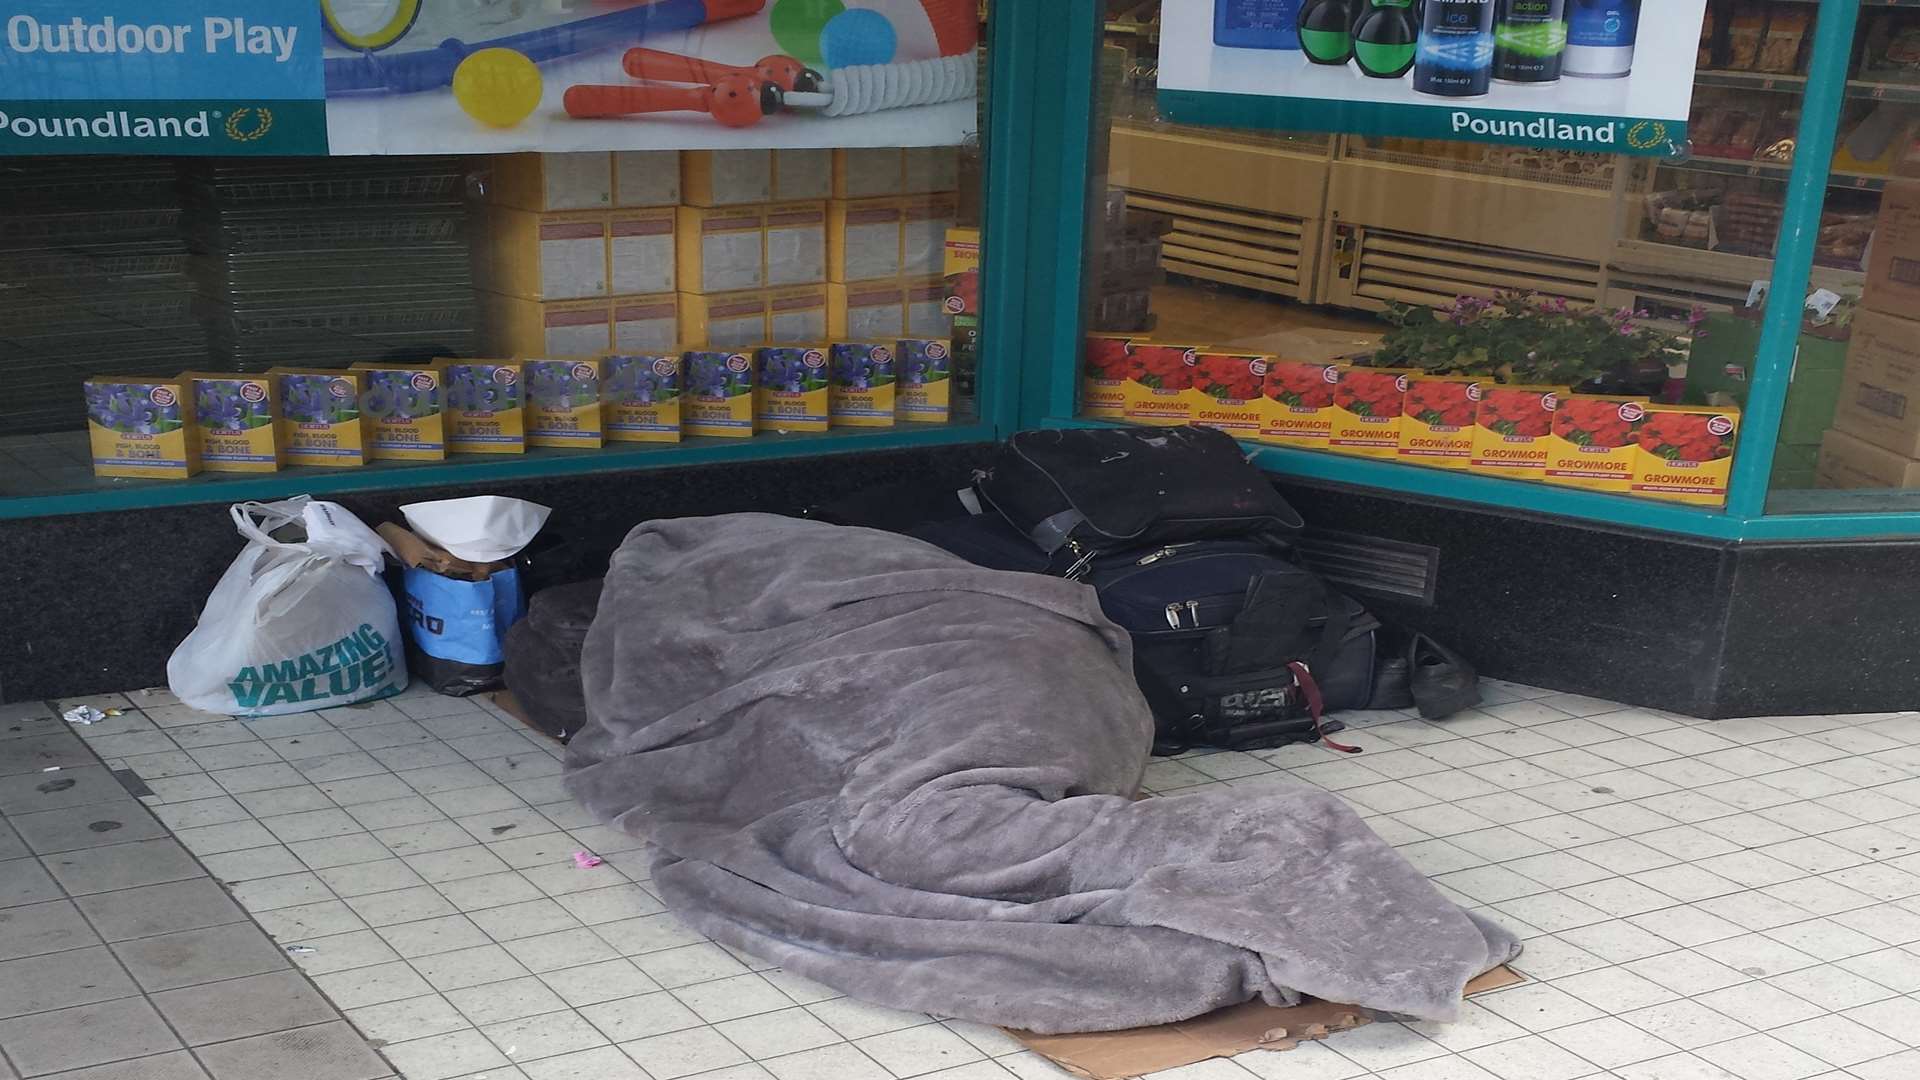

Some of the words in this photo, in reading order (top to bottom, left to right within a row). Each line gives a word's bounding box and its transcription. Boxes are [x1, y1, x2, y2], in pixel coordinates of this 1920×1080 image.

[7, 14, 192, 54] Outdoor
[205, 16, 298, 62] Play
[1451, 110, 1615, 144] Poundland
[1199, 411, 1260, 421] GROWMORE
[389, 433, 420, 442] BONE
[1340, 429, 1400, 439] GROWMOR
[304, 438, 338, 448] BONE
[1409, 438, 1472, 449] GROWMOR
[1557, 459, 1627, 471] GROWMORE
[1644, 473, 1717, 486] GROWMORE
[233, 622, 386, 683] AMAZING
[227, 641, 394, 708] VALUE!
